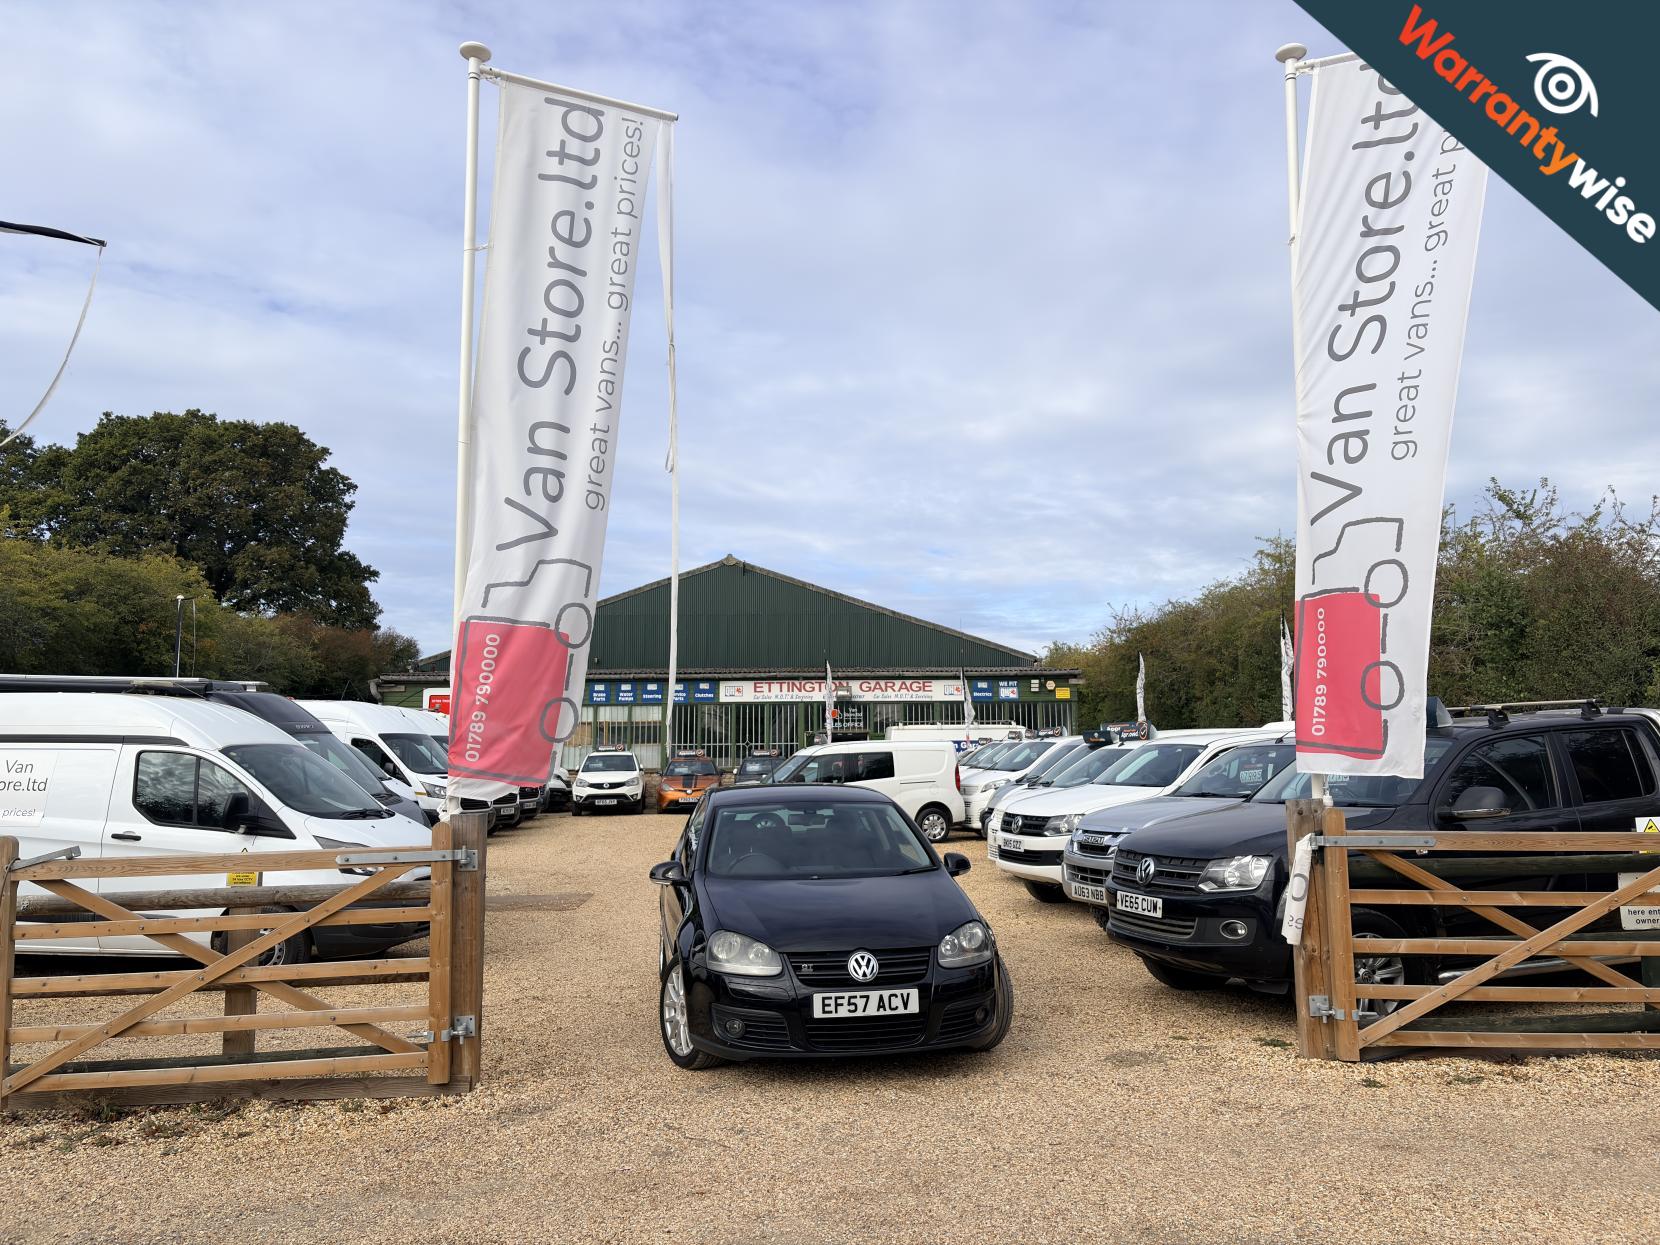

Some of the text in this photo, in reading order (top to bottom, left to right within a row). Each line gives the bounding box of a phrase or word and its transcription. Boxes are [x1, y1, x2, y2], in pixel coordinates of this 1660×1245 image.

[1425, 163, 1456, 252] great
[496, 96, 605, 551] Van Store.ltd
[585, 117, 644, 511] great vans... great prices!
[1404, 259, 1438, 361] vans...
[1310, 382, 1377, 527] Van
[1390, 369, 1422, 462] great
[465, 634, 500, 763] 01789 790000
[753, 680, 933, 693] ETTINGTON GARAGE
[1311, 608, 1328, 736] 01789 790000
[6, 759, 34, 774] Van
[2, 807, 36, 819] prices!
[1083, 834, 1105, 845] ISUZU
[1120, 893, 1140, 910] VE65
[1627, 908, 1645, 916] here
[821, 992, 911, 1015] EF57 ACV
